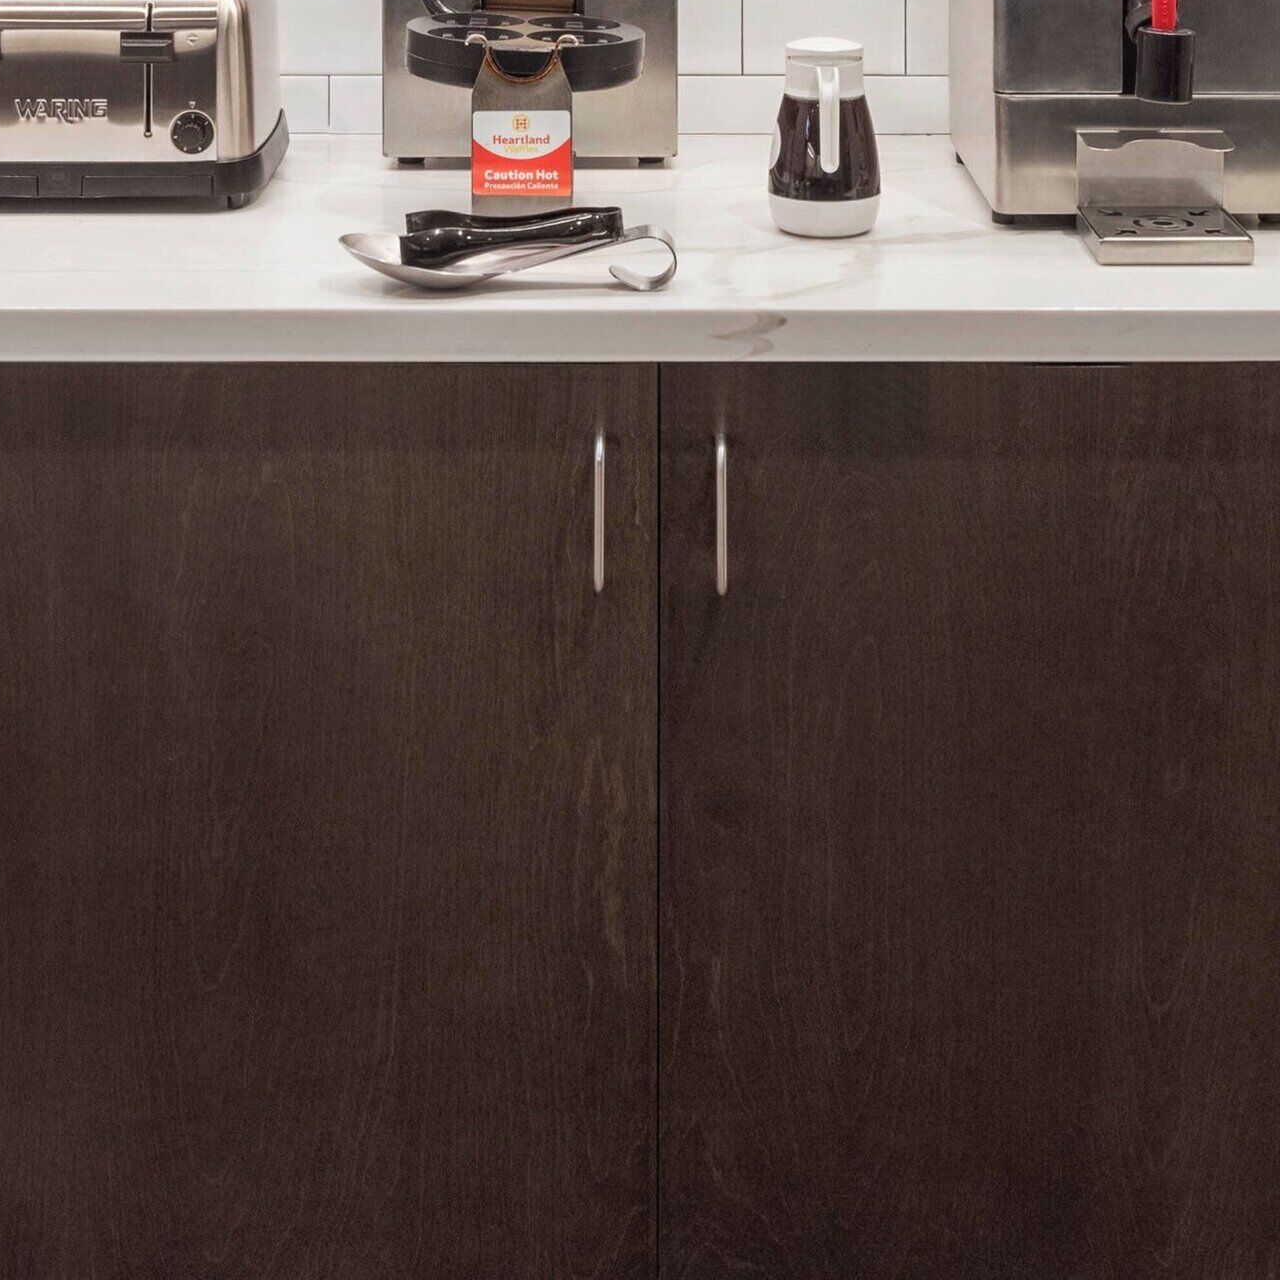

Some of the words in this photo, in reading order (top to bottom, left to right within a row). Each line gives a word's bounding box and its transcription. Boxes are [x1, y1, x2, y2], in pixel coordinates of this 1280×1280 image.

[14, 98, 108, 123] WARING
[492, 134, 550, 145] Heartland
[484, 169, 533, 180] Caution
[535, 169, 559, 180] Hot
[484, 182, 526, 190] Precaución
[527, 182, 559, 190] Caliente
